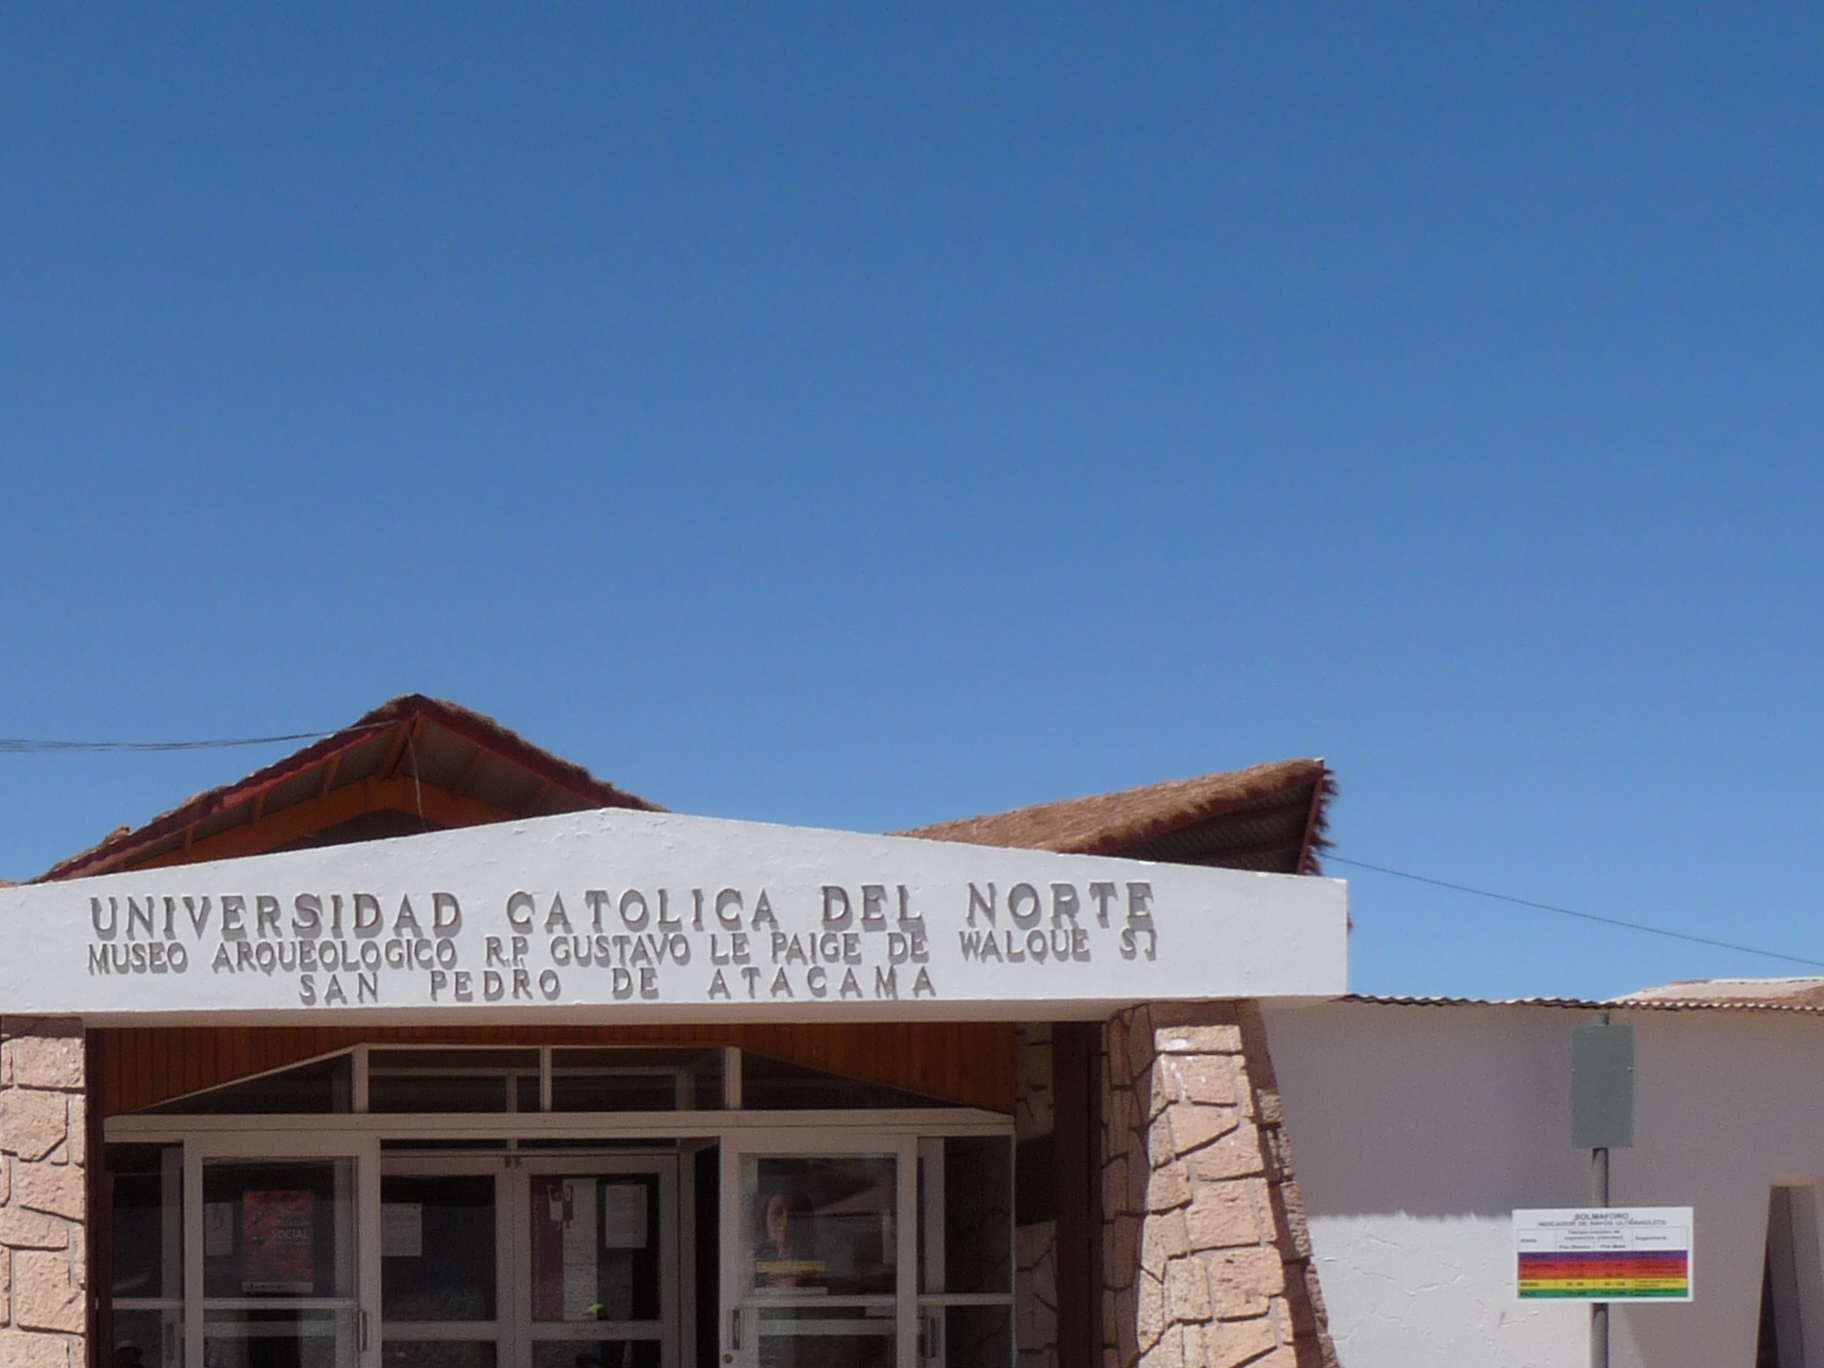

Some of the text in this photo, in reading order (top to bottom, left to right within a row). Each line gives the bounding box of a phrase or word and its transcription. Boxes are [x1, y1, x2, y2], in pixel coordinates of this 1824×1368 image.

[89, 882, 1153, 938] UNIVERSIDAD CATOLICA DEL NORTE
[88, 942, 188, 974] MUSEO
[211, 936, 457, 976] ARQUEOLOGICO
[550, 933, 691, 968] GUSTAVO
[710, 932, 751, 965] LE
[771, 931, 862, 965] PAIGE
[887, 930, 929, 964] DE
[959, 928, 1091, 964] WALQUE
[299, 964, 936, 1005] SAN PEDRO DE ATACAMA
